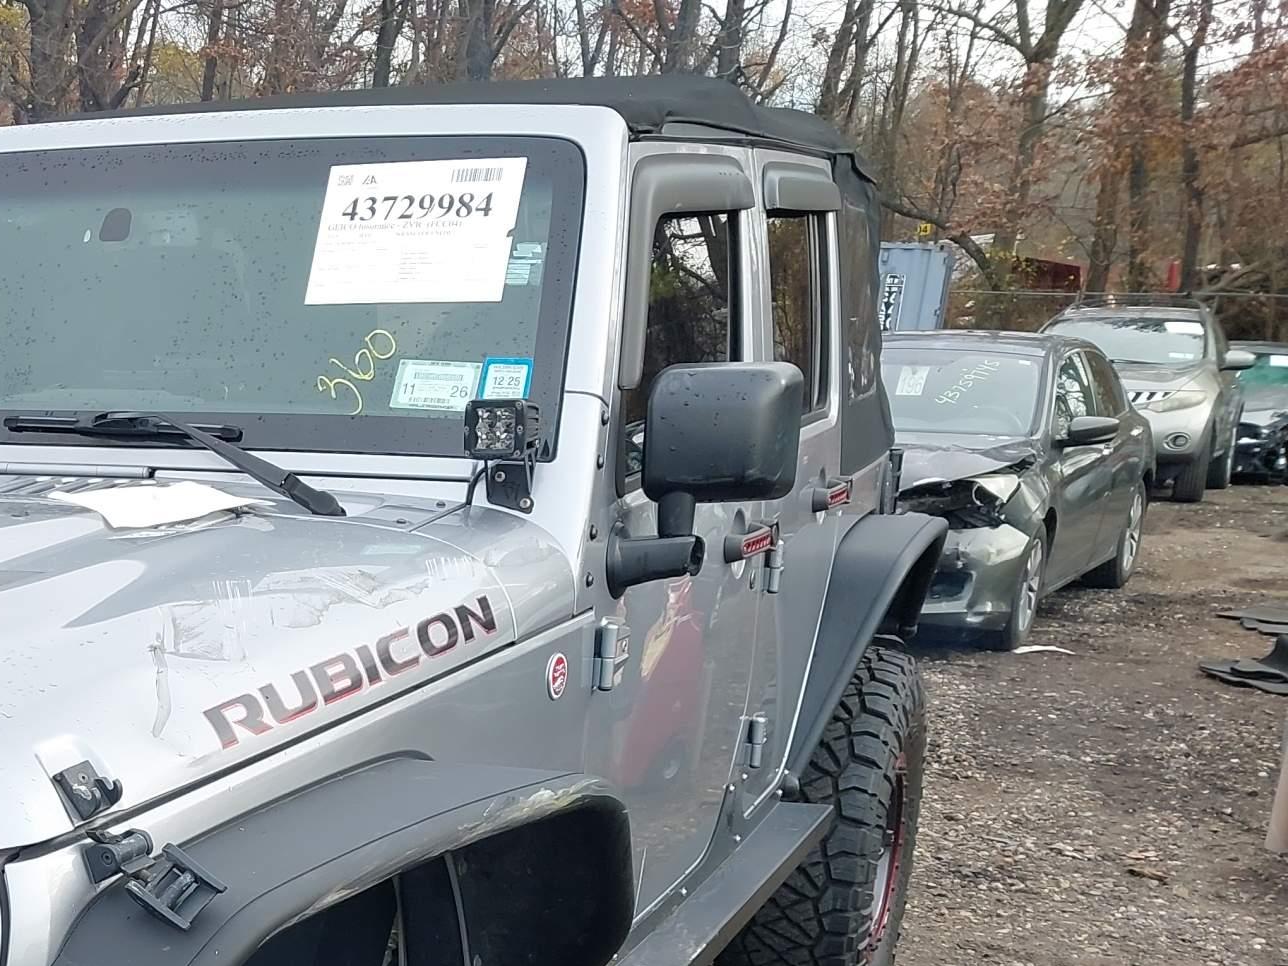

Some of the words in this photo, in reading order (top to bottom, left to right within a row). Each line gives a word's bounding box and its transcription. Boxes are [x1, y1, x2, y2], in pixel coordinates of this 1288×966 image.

[342, 192, 493, 221] 43729984
[317, 329, 396, 415] 360
[402, 383, 416, 395] 11
[450, 385, 469, 399] 26
[203, 594, 499, 749] RUBICON
